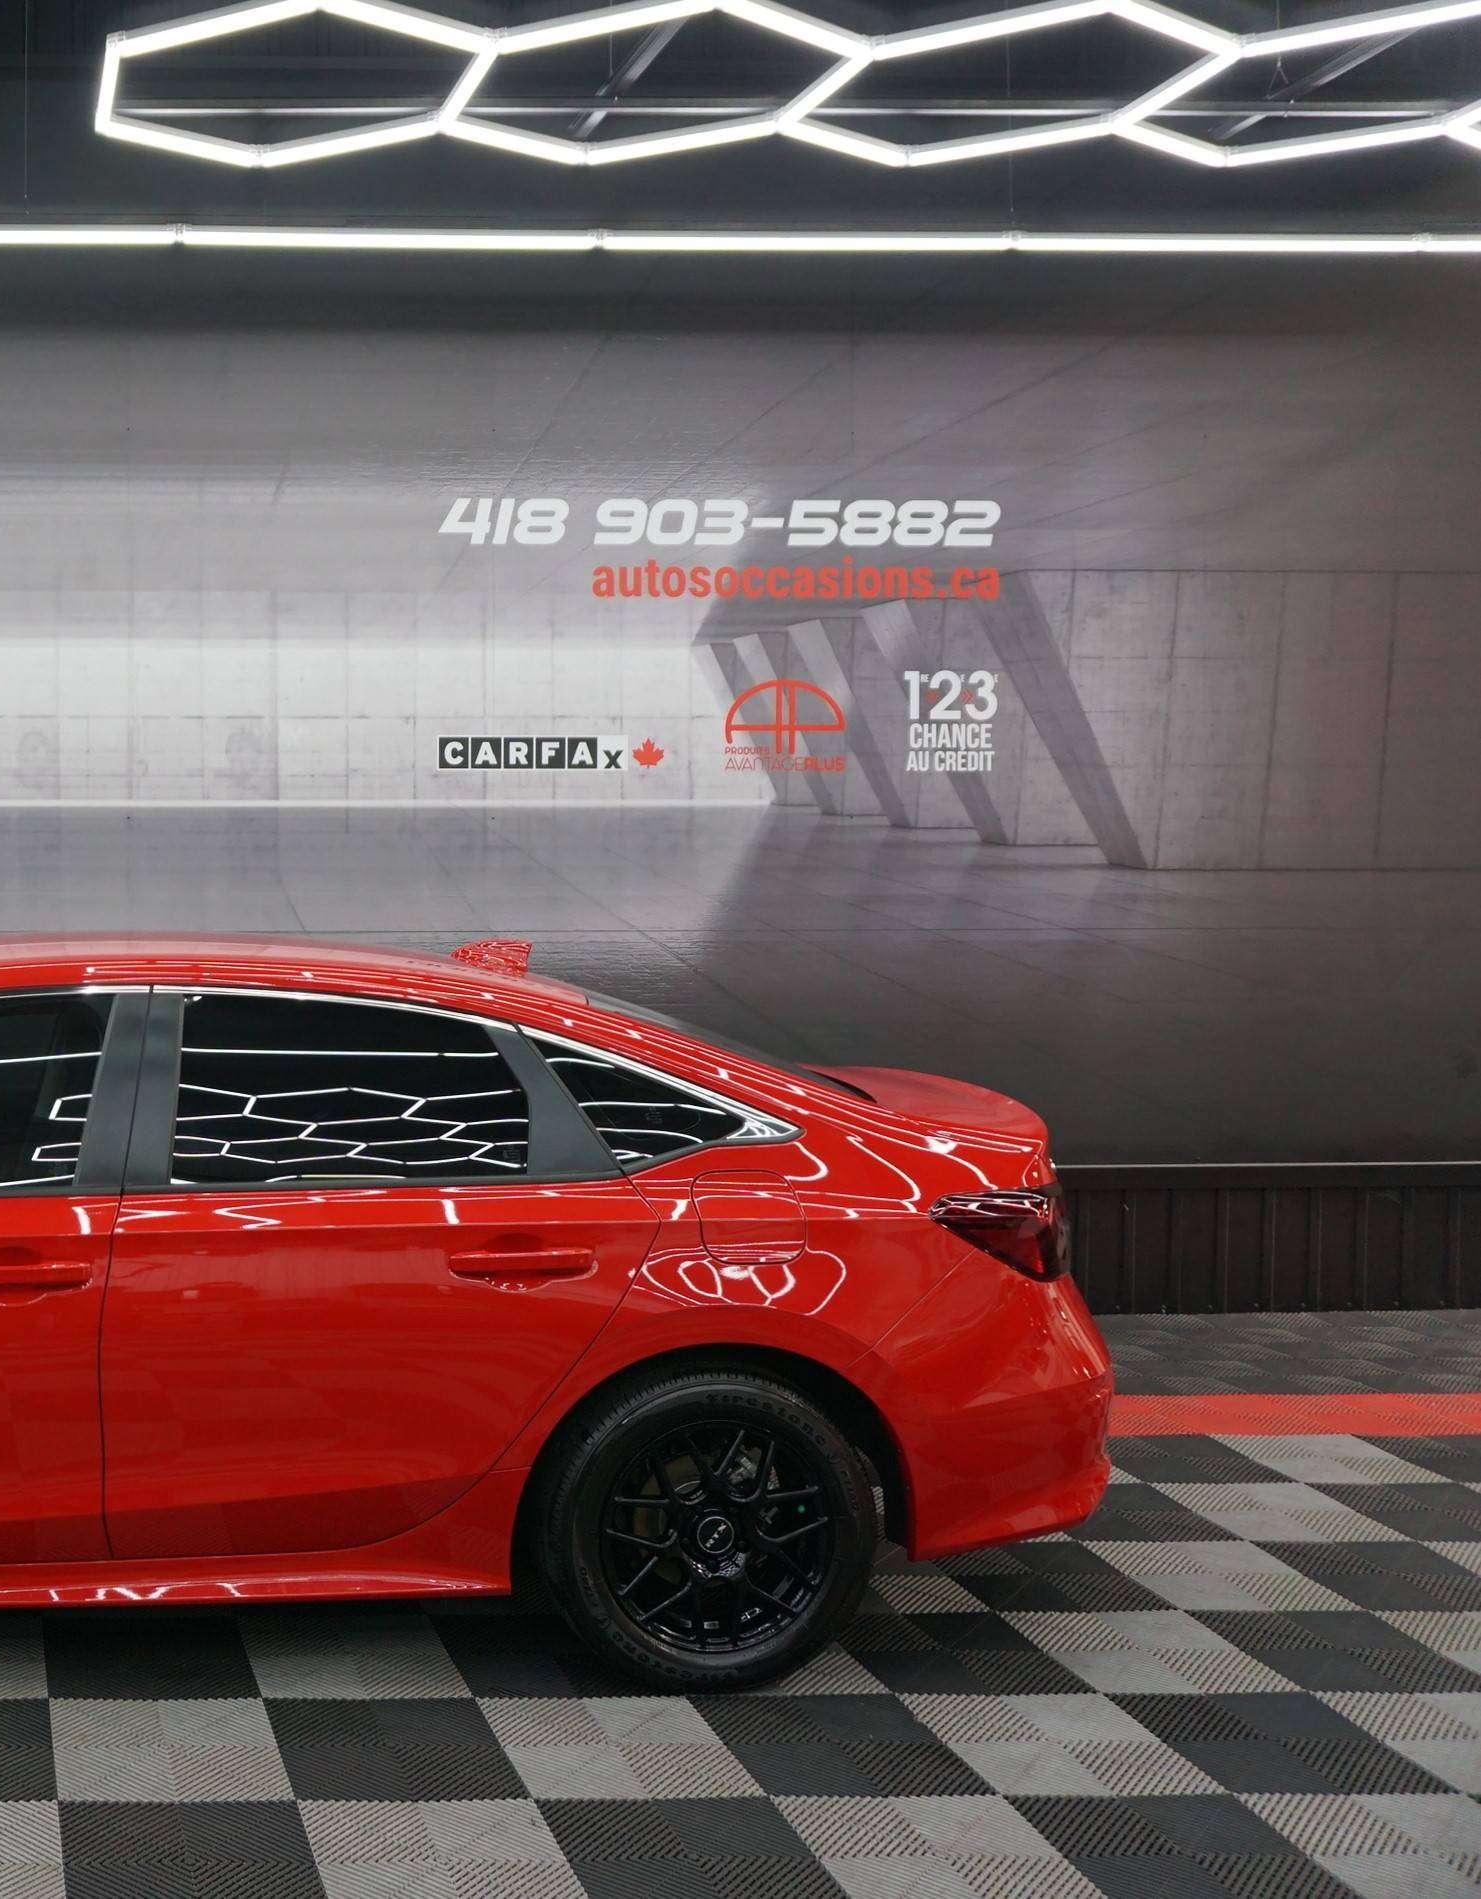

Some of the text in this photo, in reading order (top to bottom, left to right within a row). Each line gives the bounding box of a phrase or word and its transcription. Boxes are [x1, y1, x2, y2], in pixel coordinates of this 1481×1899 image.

[439, 497, 1002, 548] 418 903-5882
[592, 557, 1000, 598] autosoccasions.ca
[909, 722, 993, 749] CHANCE
[906, 744, 995, 771] AU CRÉDIT
